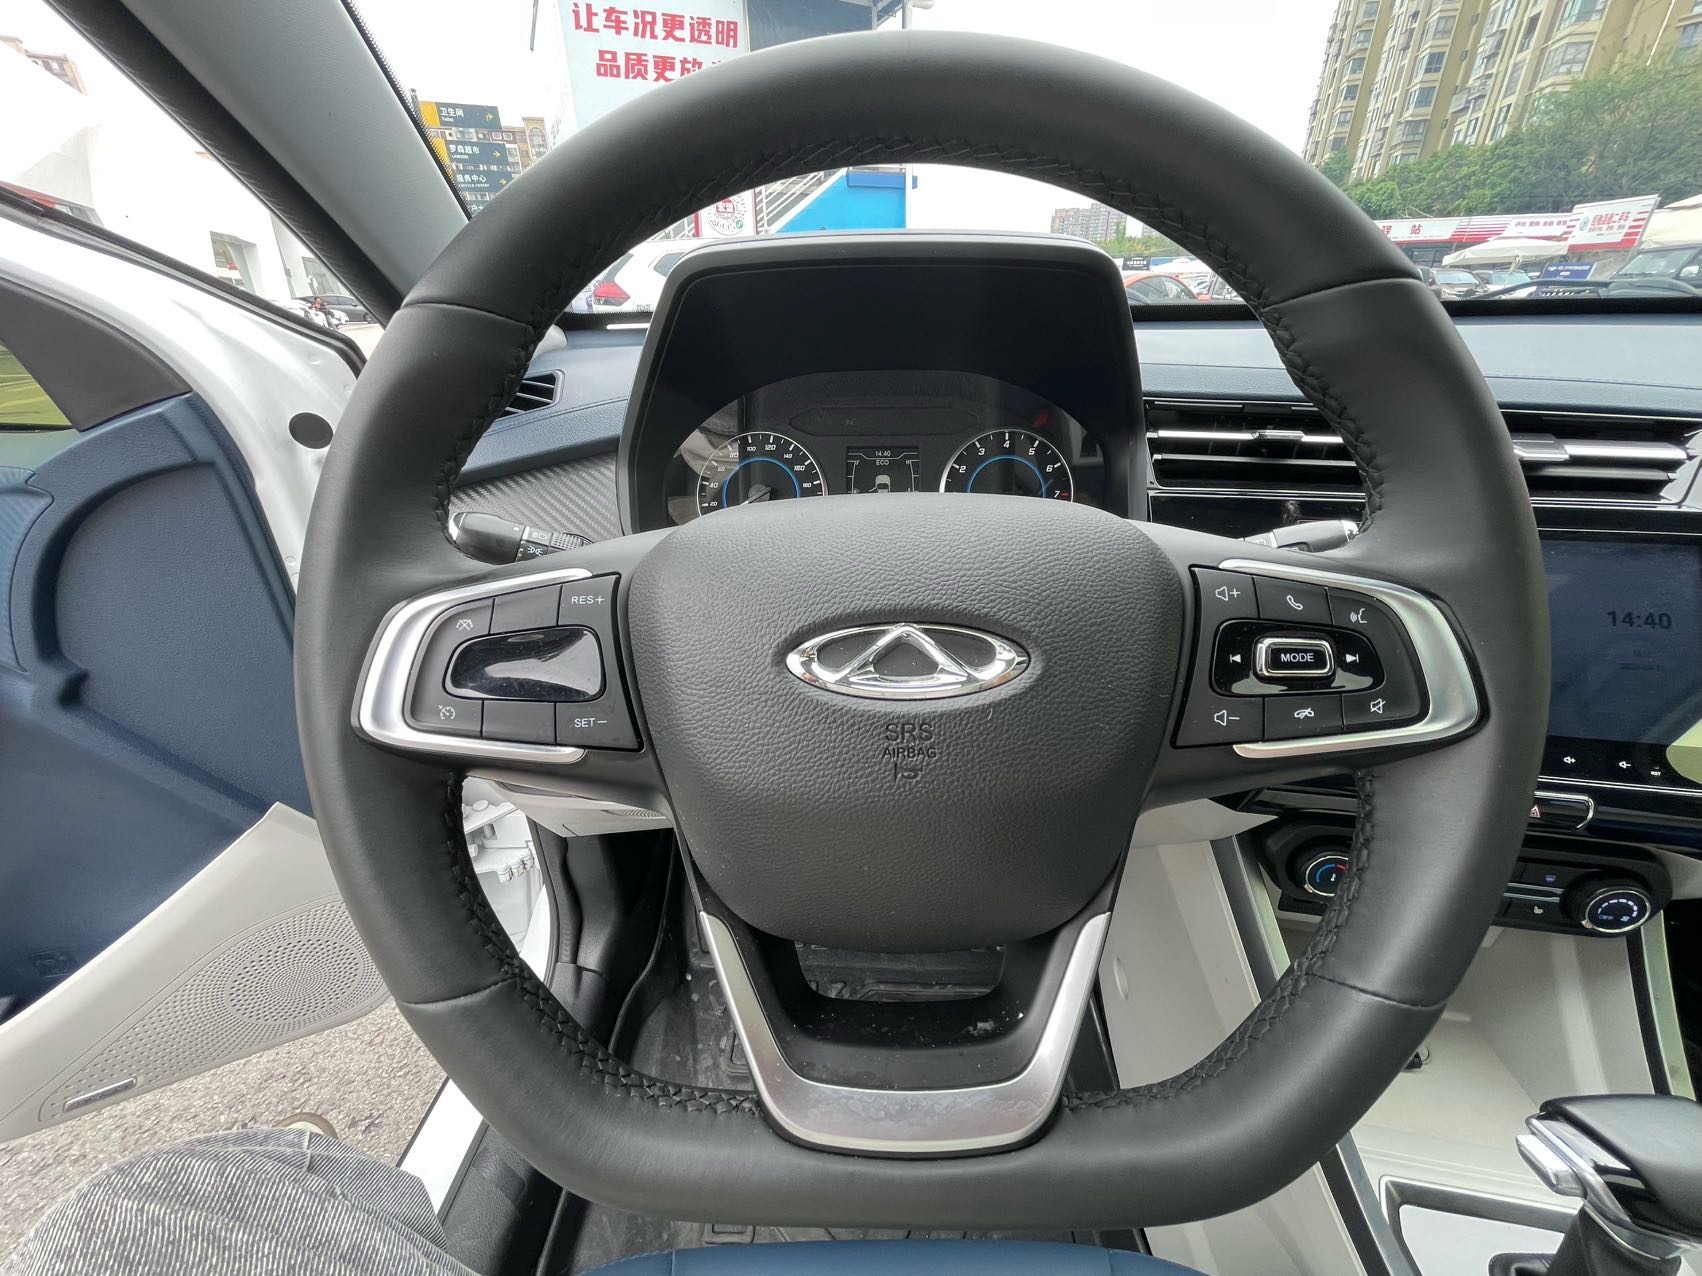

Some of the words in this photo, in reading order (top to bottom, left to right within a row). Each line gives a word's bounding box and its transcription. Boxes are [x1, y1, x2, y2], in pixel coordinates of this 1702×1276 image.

[572, 2, 738, 48] 让车况更透明
[596, 49, 722, 82] 品质更放
[440, 107, 464, 117] 卫生间
[457, 174, 486, 183] 服务中心
[1003, 440, 1011, 448] 4
[1028, 447, 1036, 455] 5
[959, 465, 966, 473] 2
[1607, 611, 1672, 630] 14:40
[1280, 653, 1314, 662] MODE
[885, 723, 934, 742] SRS
[882, 747, 937, 759] AIRBAG
